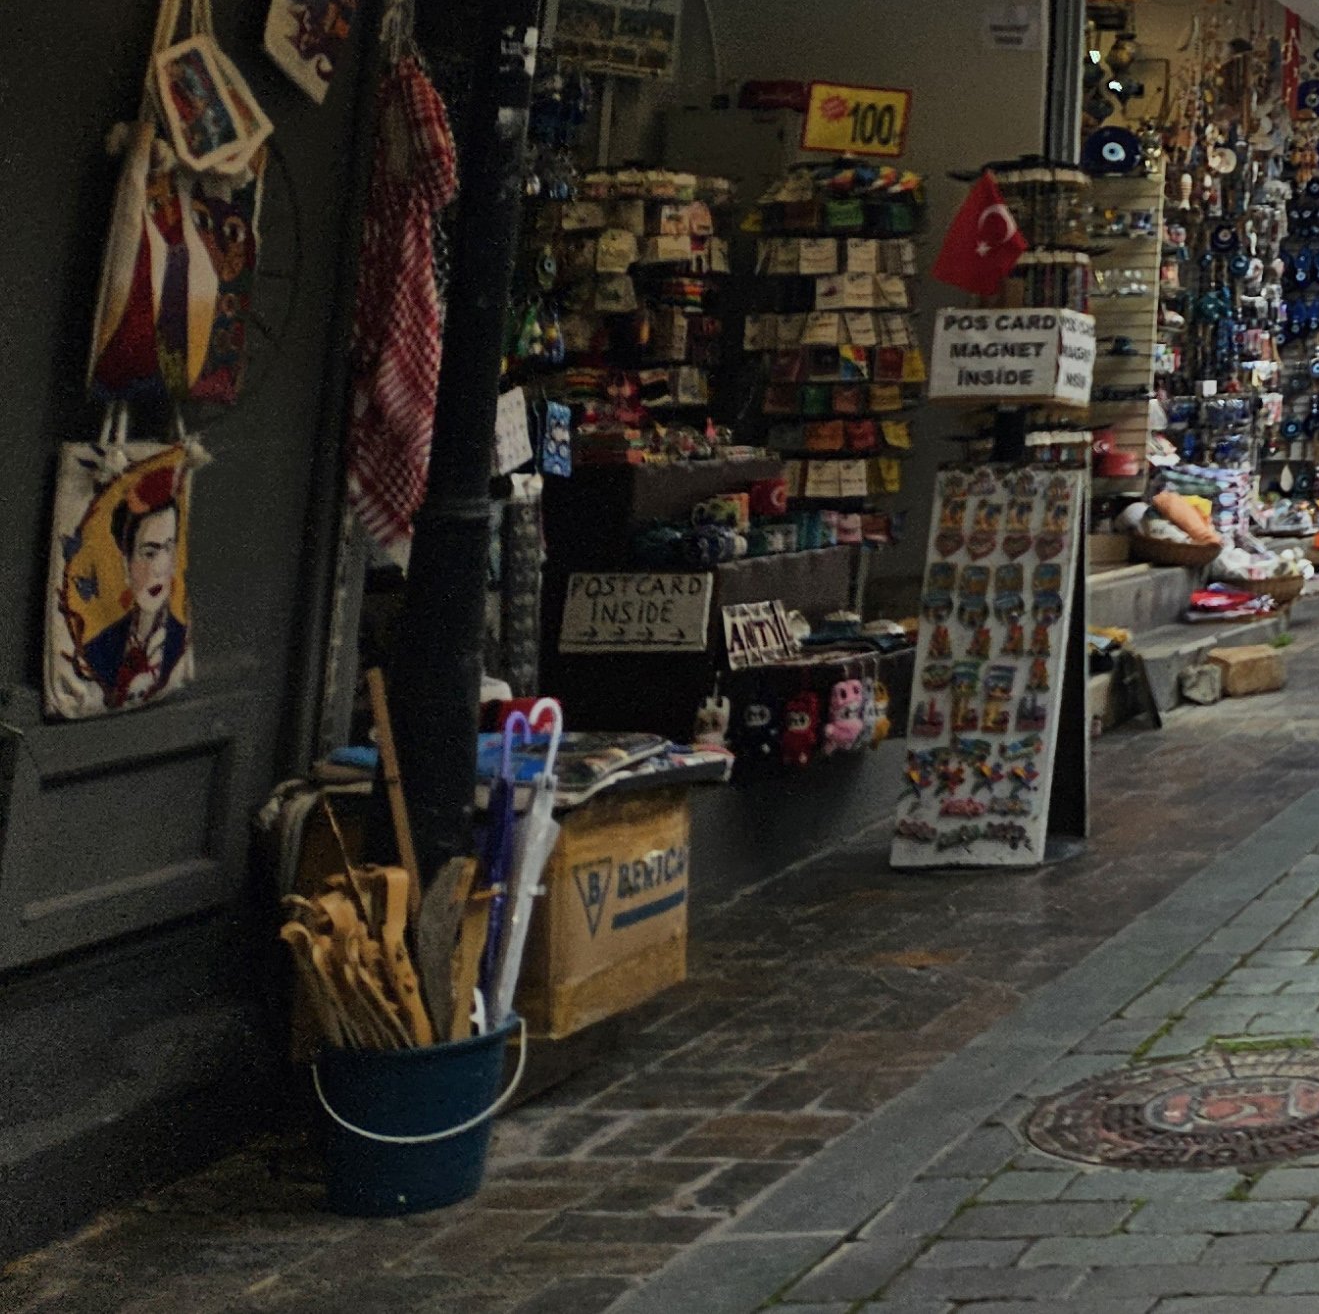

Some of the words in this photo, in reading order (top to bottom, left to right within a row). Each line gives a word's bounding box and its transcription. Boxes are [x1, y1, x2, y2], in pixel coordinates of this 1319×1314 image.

[848, 101, 895, 145] 100
[944, 314, 989, 331] POS
[994, 314, 1057, 331] CARD
[949, 342, 1046, 358] MAGNET
[571, 575, 703, 599] POSTCARD
[590, 598, 676, 625] INSIDE
